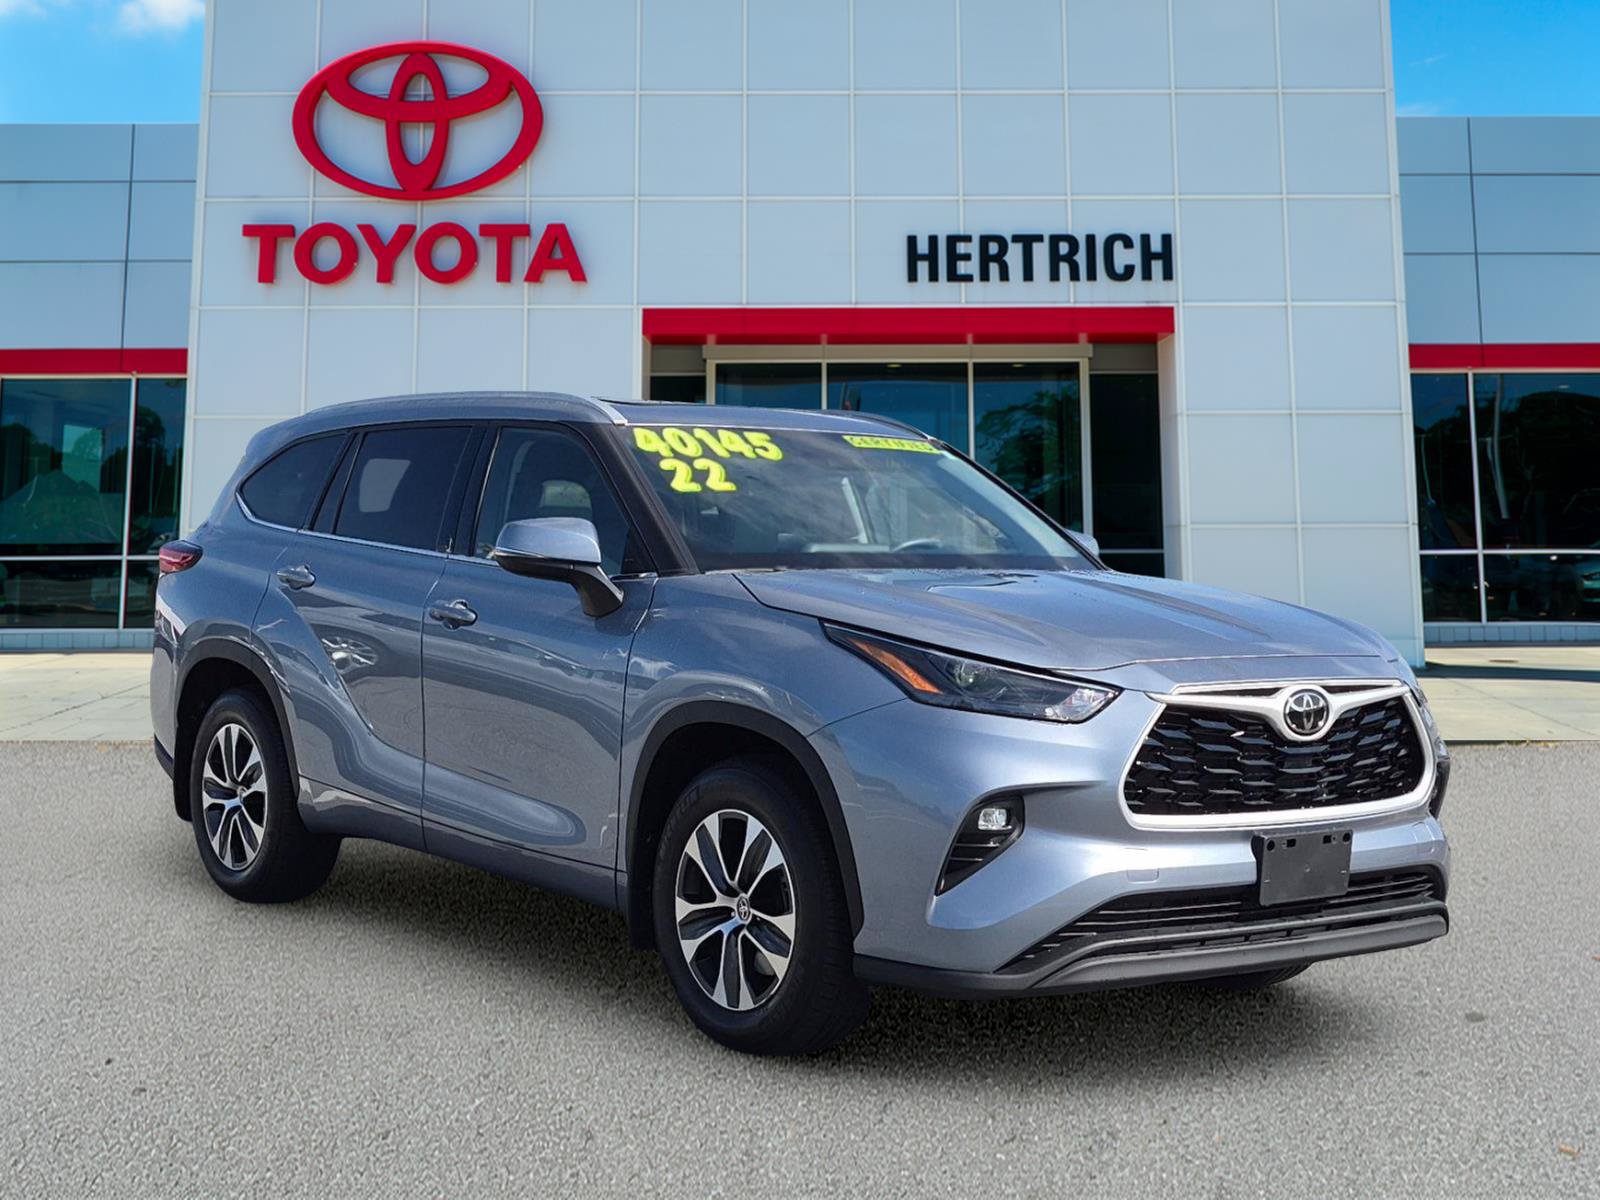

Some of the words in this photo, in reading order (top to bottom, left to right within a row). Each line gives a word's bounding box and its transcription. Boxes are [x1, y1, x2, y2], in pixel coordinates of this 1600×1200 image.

[242, 222, 587, 285] TOYOTA
[906, 233, 1174, 283] HERTRICH
[633, 426, 783, 461] 40145
[659, 458, 737, 492] 22
